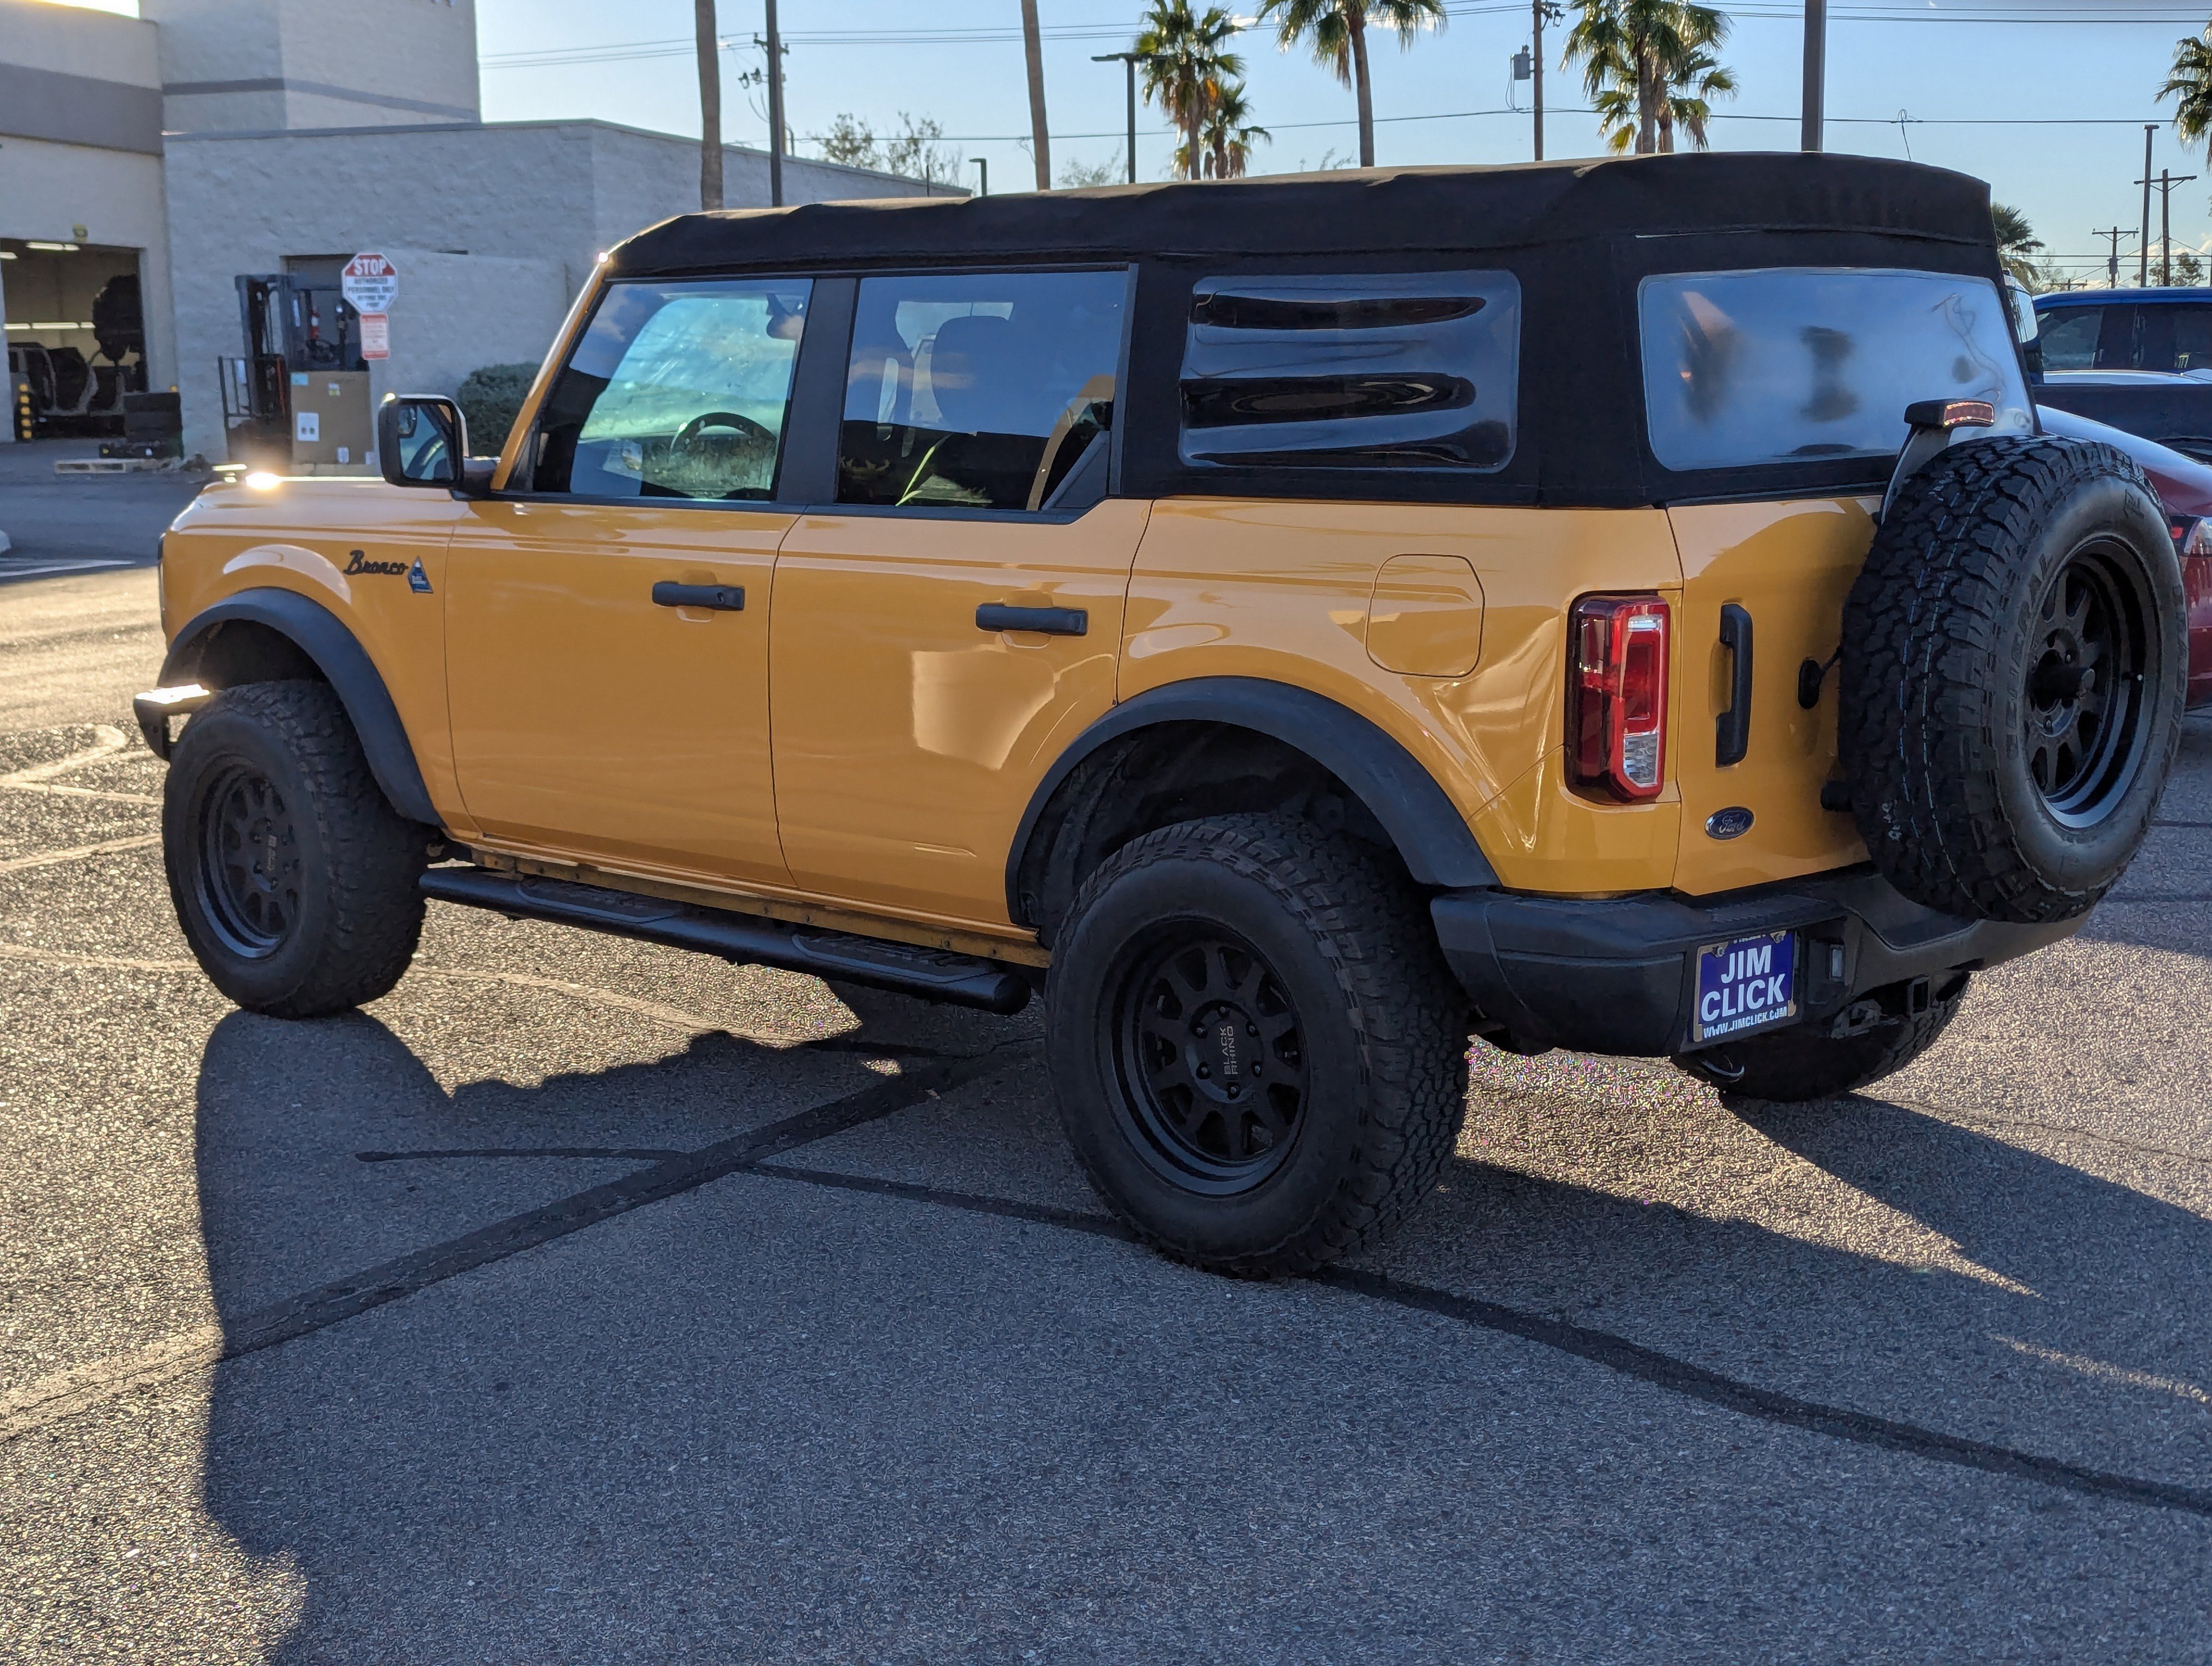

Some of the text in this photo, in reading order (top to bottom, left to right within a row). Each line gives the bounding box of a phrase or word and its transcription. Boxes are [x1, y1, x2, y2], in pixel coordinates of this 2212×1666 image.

[353, 258, 387, 275] STOP
[343, 549, 409, 575] Bronco
[1719, 815, 1746, 834] Ford
[1721, 945, 1772, 984] JIM
[1701, 973, 1786, 1022] CLICK
[1220, 1027, 1232, 1075] BLACK
[1227, 1026, 1239, 1075] RHINO
